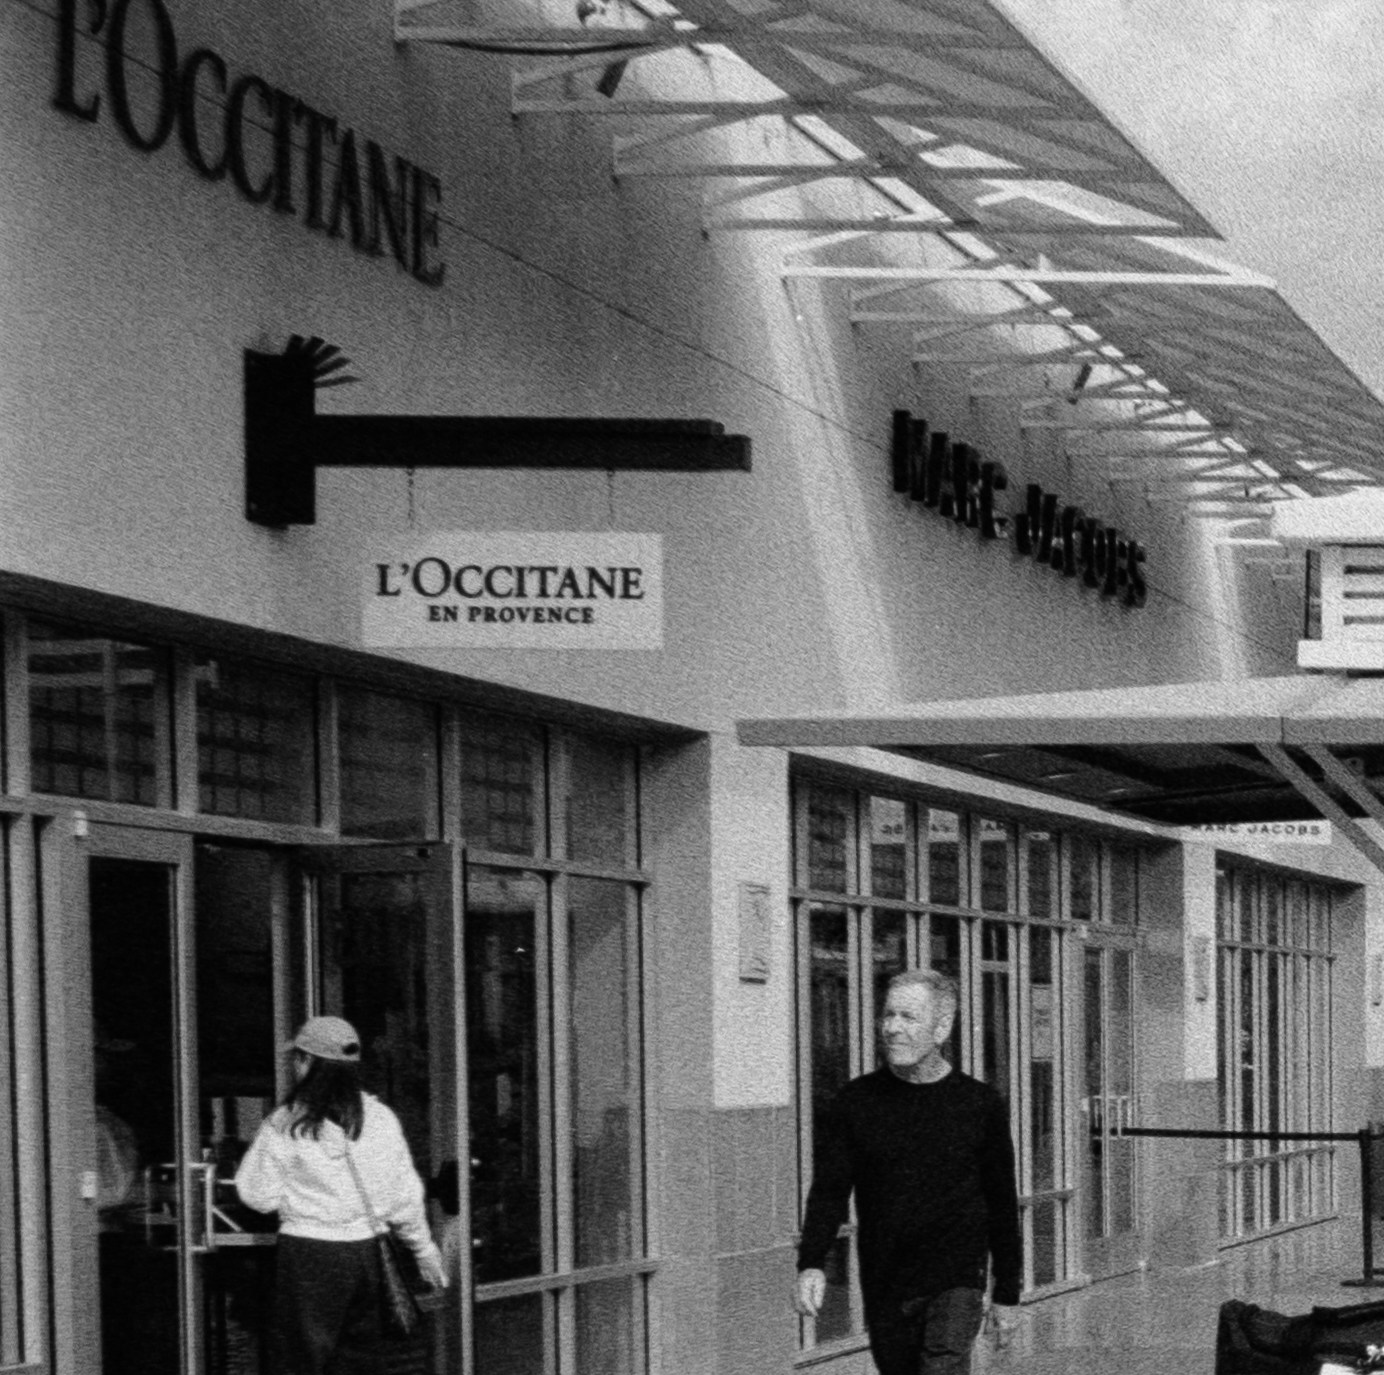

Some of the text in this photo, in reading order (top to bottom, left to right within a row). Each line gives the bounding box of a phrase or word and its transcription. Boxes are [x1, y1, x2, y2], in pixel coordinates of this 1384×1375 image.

[893, 410, 1146, 608] MARC JACOBS
[376, 557, 645, 599] L'OCCITANE
[428, 605, 594, 623] EN PROVENCE
[1247, 823, 1321, 835] JACOBS
